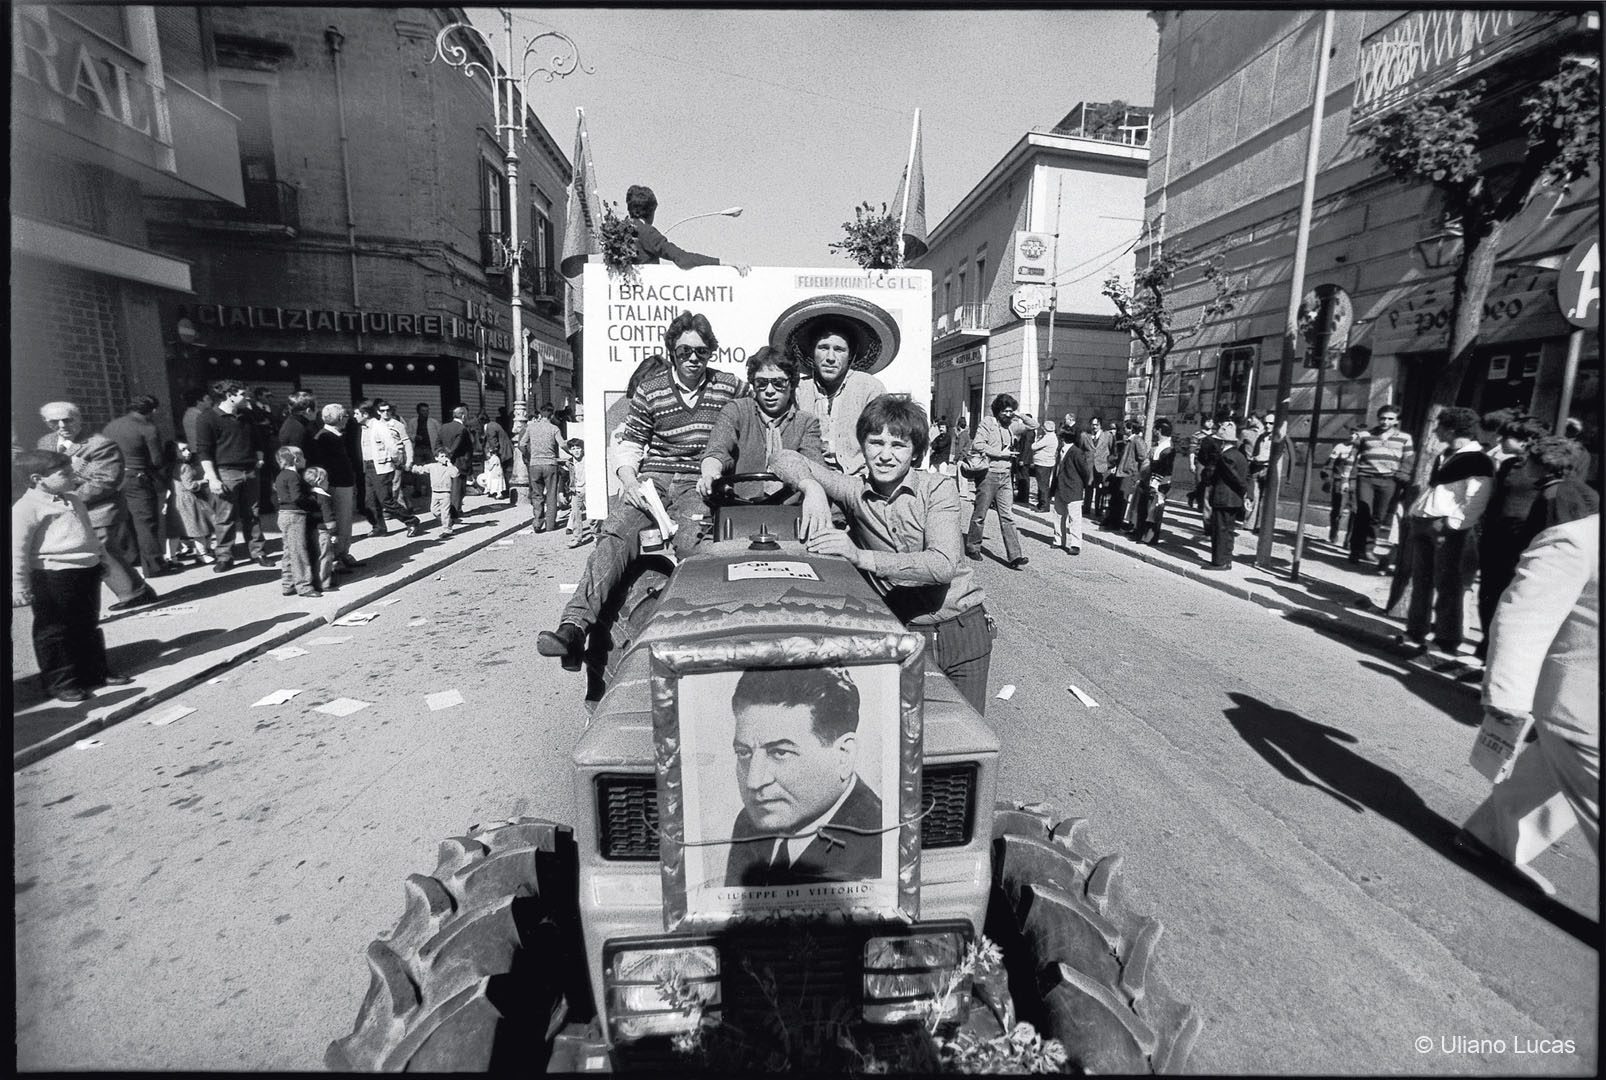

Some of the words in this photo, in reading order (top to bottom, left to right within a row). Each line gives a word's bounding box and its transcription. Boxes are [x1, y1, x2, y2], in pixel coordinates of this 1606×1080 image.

[608, 284, 612, 301] I
[620, 285, 734, 302] BRACCIANTI
[199, 305, 438, 333] CALZATURE
[608, 304, 678, 321] ITALIANI
[608, 325, 668, 342] CONTR
[609, 346, 622, 362] IL
[717, 890, 778, 900] GIUSEPPE
[786, 889, 800, 898] DI
[808, 885, 870, 897] VITTORIO
